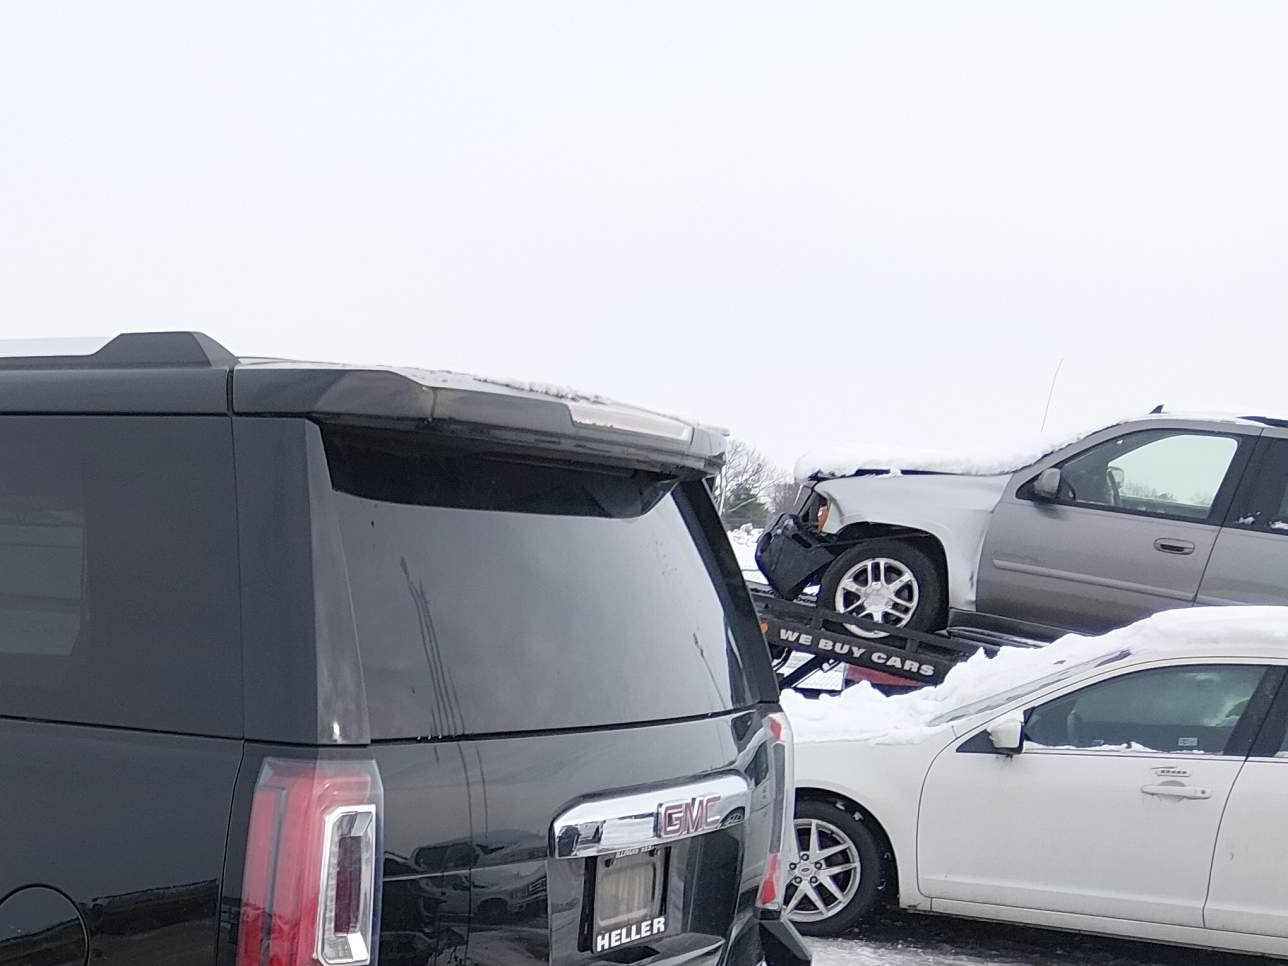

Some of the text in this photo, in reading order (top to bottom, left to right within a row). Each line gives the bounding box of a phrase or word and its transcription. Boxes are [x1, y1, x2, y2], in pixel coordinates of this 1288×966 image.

[779, 628, 935, 677] WE BUY CARS
[663, 794, 722, 837] GMC
[597, 917, 665, 952] HELLER
